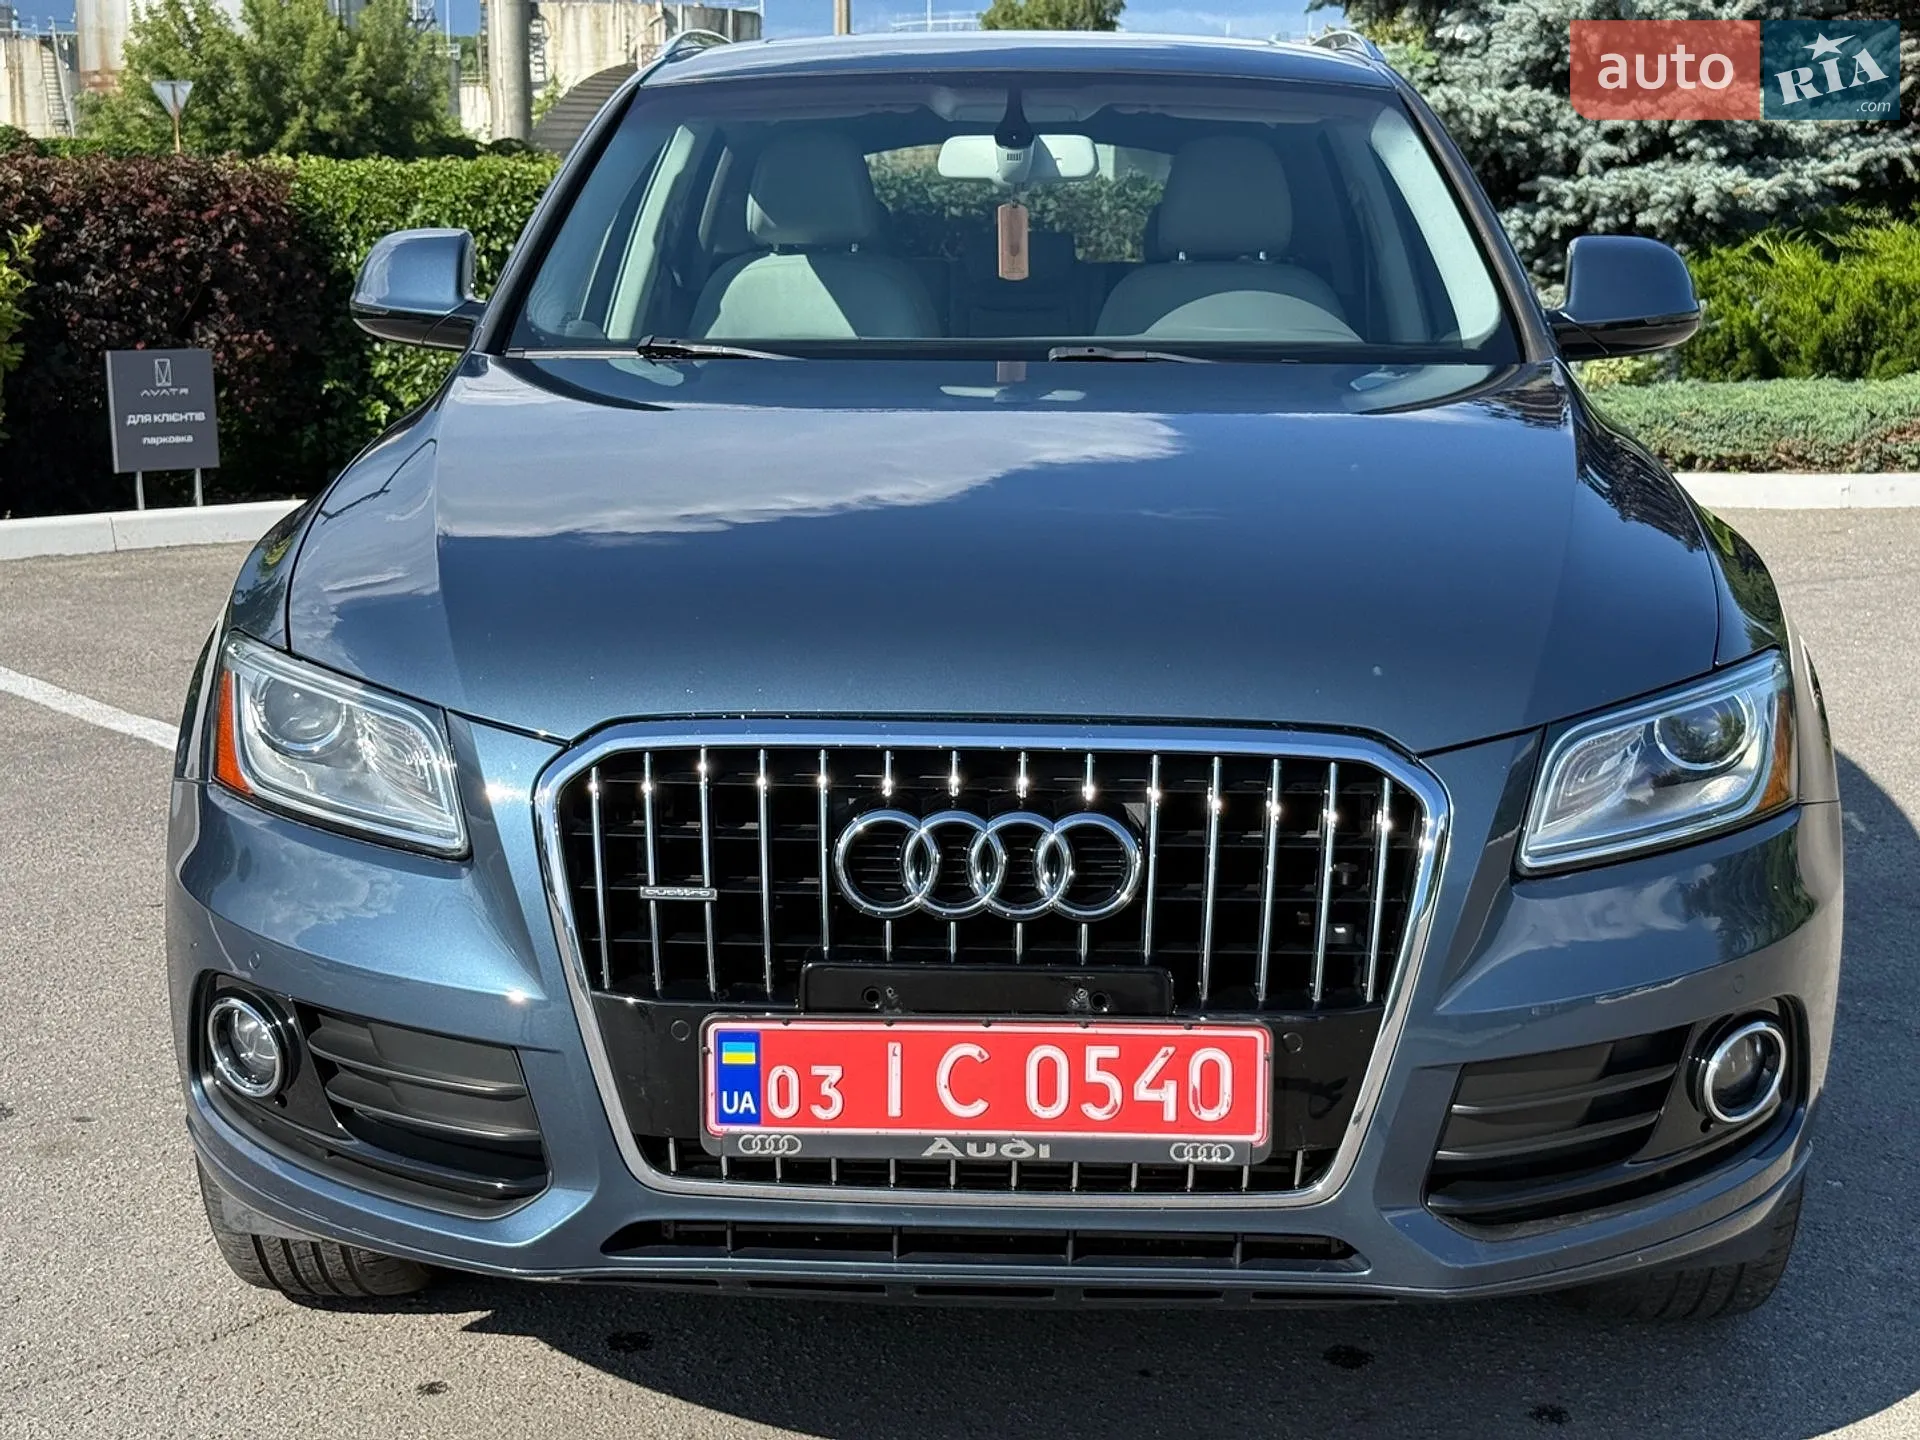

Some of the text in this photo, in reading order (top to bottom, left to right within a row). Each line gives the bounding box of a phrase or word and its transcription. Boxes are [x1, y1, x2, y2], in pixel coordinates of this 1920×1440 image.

[126, 411, 206, 426] ДЛЯ КЛІЄНТІВ
[142, 434, 194, 447] парковка
[767, 1064, 844, 1120] 03
[1025, 1043, 1233, 1122] 0540
[722, 1090, 756, 1114] UA
[920, 1137, 1050, 1159] Audi
